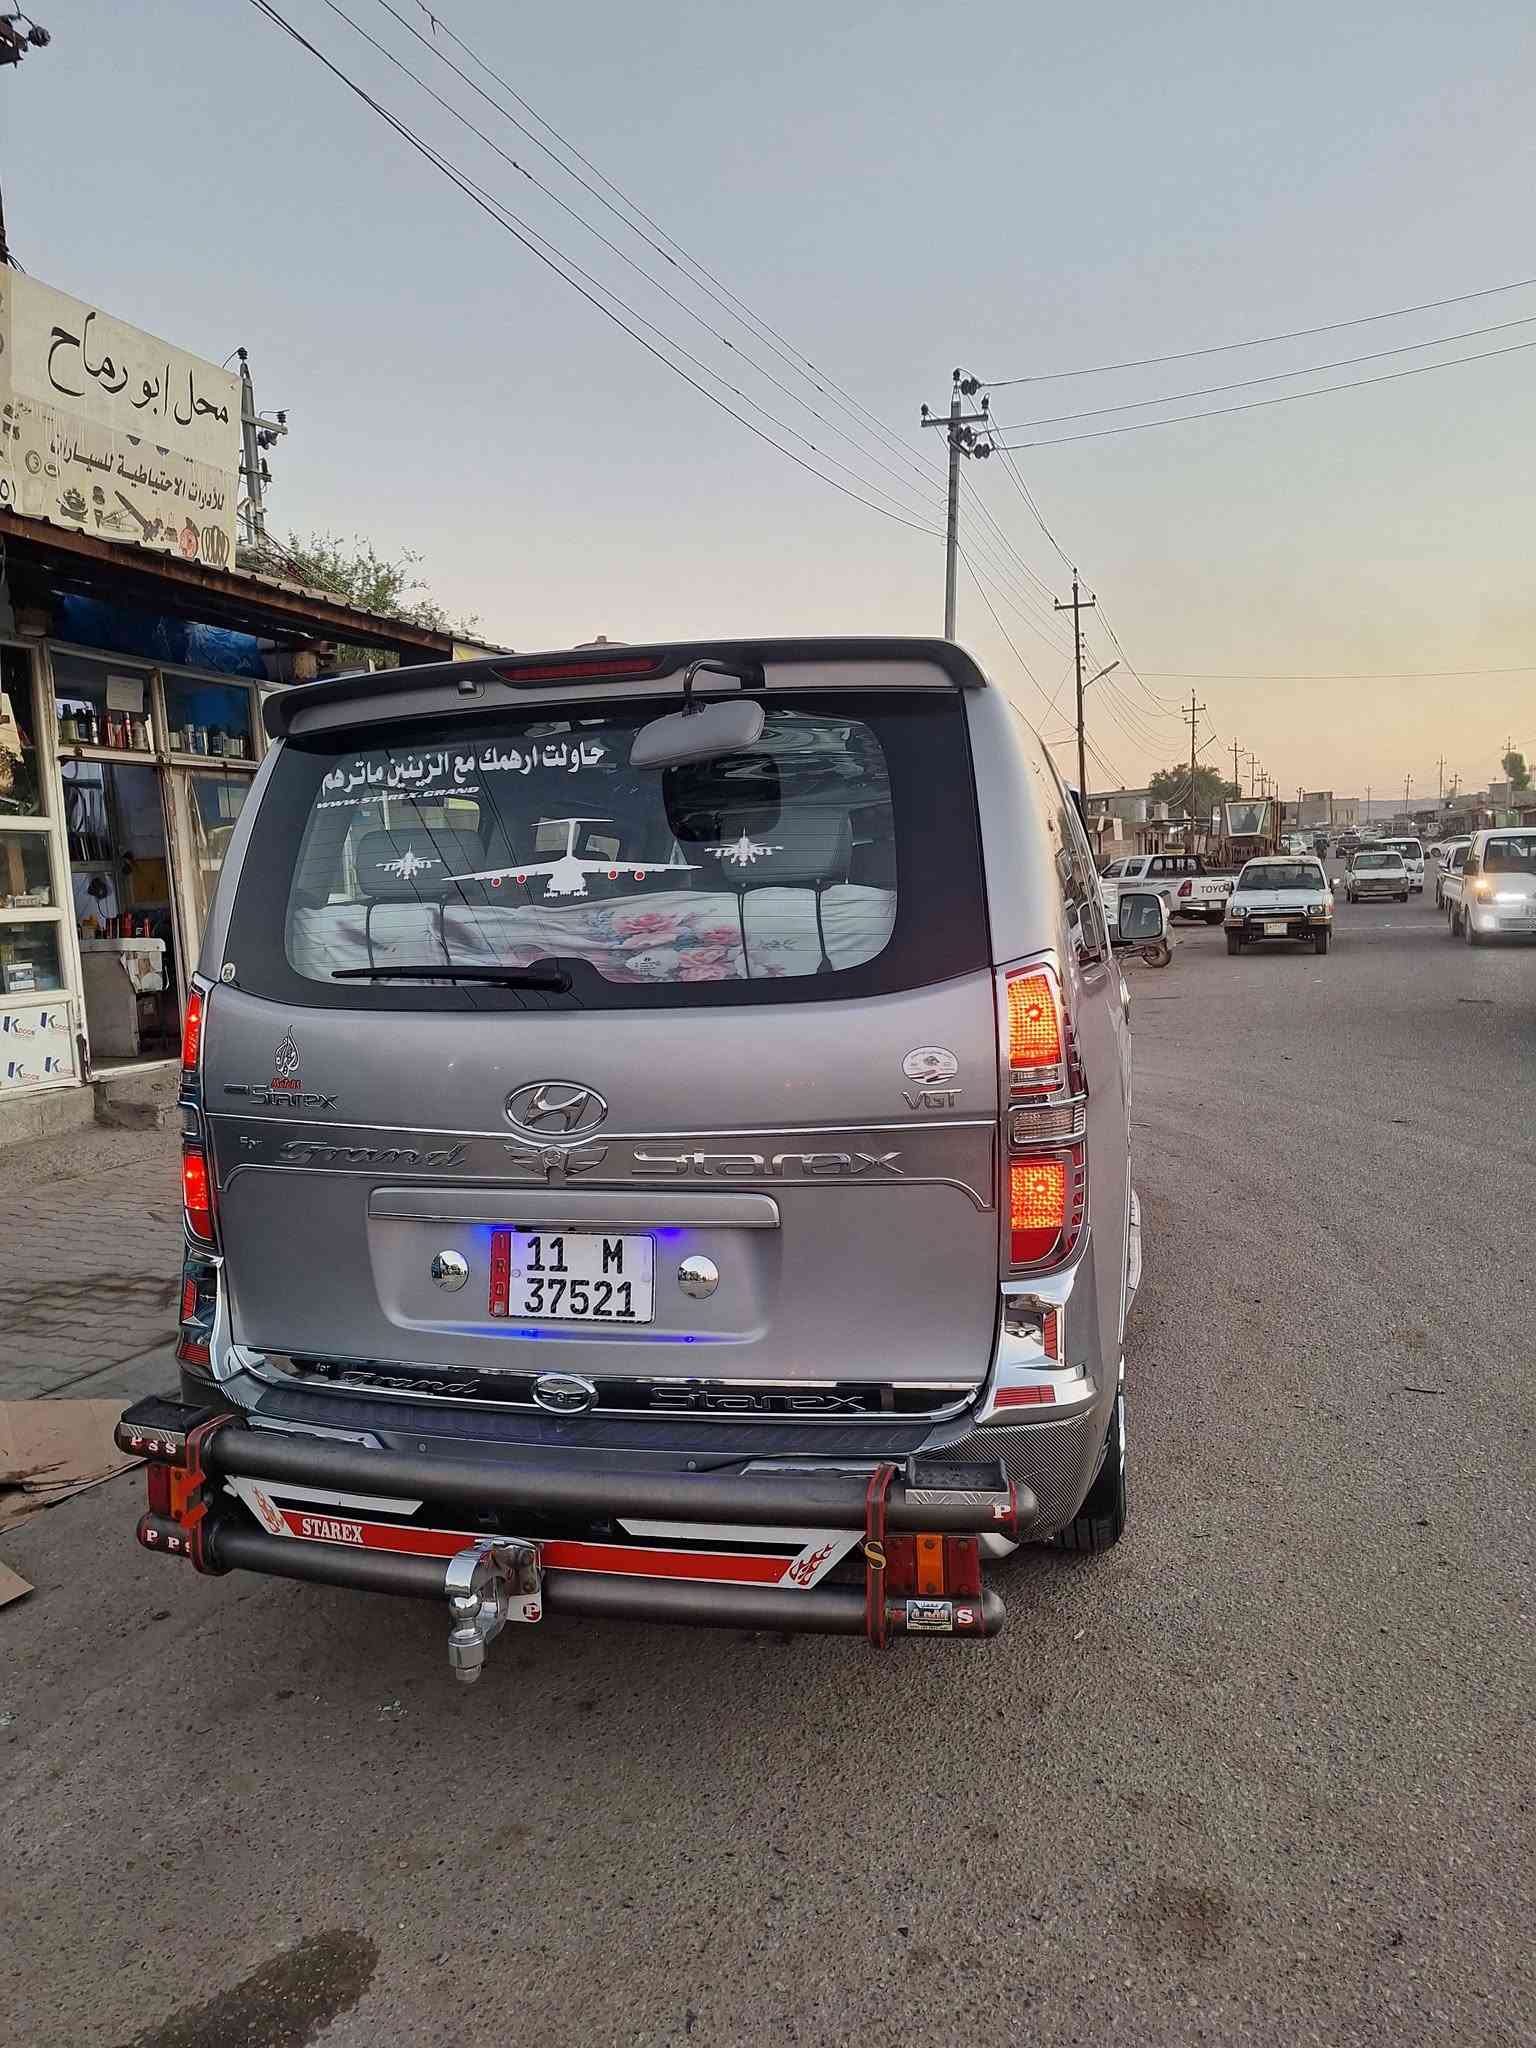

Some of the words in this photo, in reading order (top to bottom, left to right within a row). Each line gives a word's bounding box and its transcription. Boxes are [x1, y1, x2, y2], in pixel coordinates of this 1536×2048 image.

[48, 311, 128, 397] رماح
[131, 363, 170, 415] ابو
[174, 369, 229, 425] محل
[117, 454, 185, 496] الاحتياطية
[453, 755, 475, 784] مع
[479, 744, 538, 775] ارهمك
[542, 741, 605, 773] حاولت
[1200, 884, 1231, 894] TOYO
[632, 1143, 904, 1176] Starex
[526, 1236, 568, 1273] 11
[602, 1238, 624, 1275] M
[524, 1277, 636, 1318] 37521
[302, 1518, 364, 1544] STAREX
